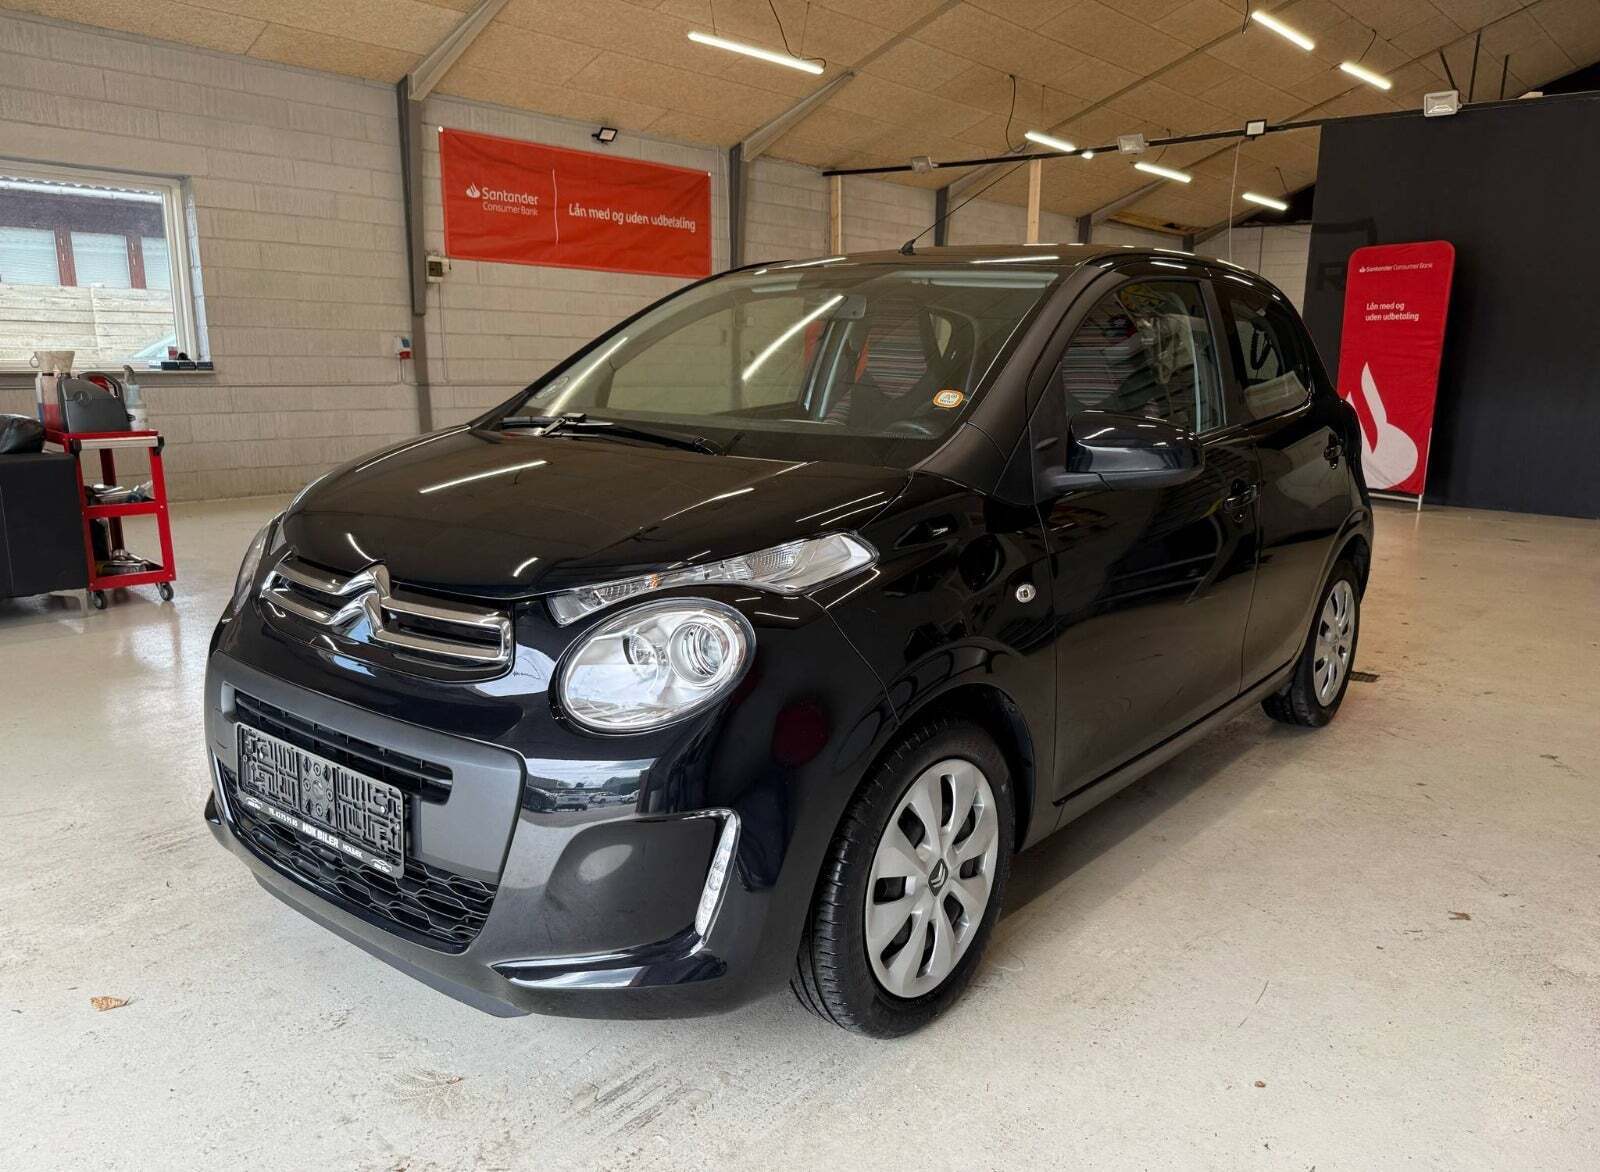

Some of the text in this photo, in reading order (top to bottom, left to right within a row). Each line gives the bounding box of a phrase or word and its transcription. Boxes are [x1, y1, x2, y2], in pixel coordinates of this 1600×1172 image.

[482, 187, 538, 205] Santander
[482, 201, 538, 216] Consumer Bank
[568, 202, 696, 233] Lån med og uden udbetaling
[1366, 301, 1405, 311] Lån med og
[1365, 312, 1419, 321] uden udbetaling
